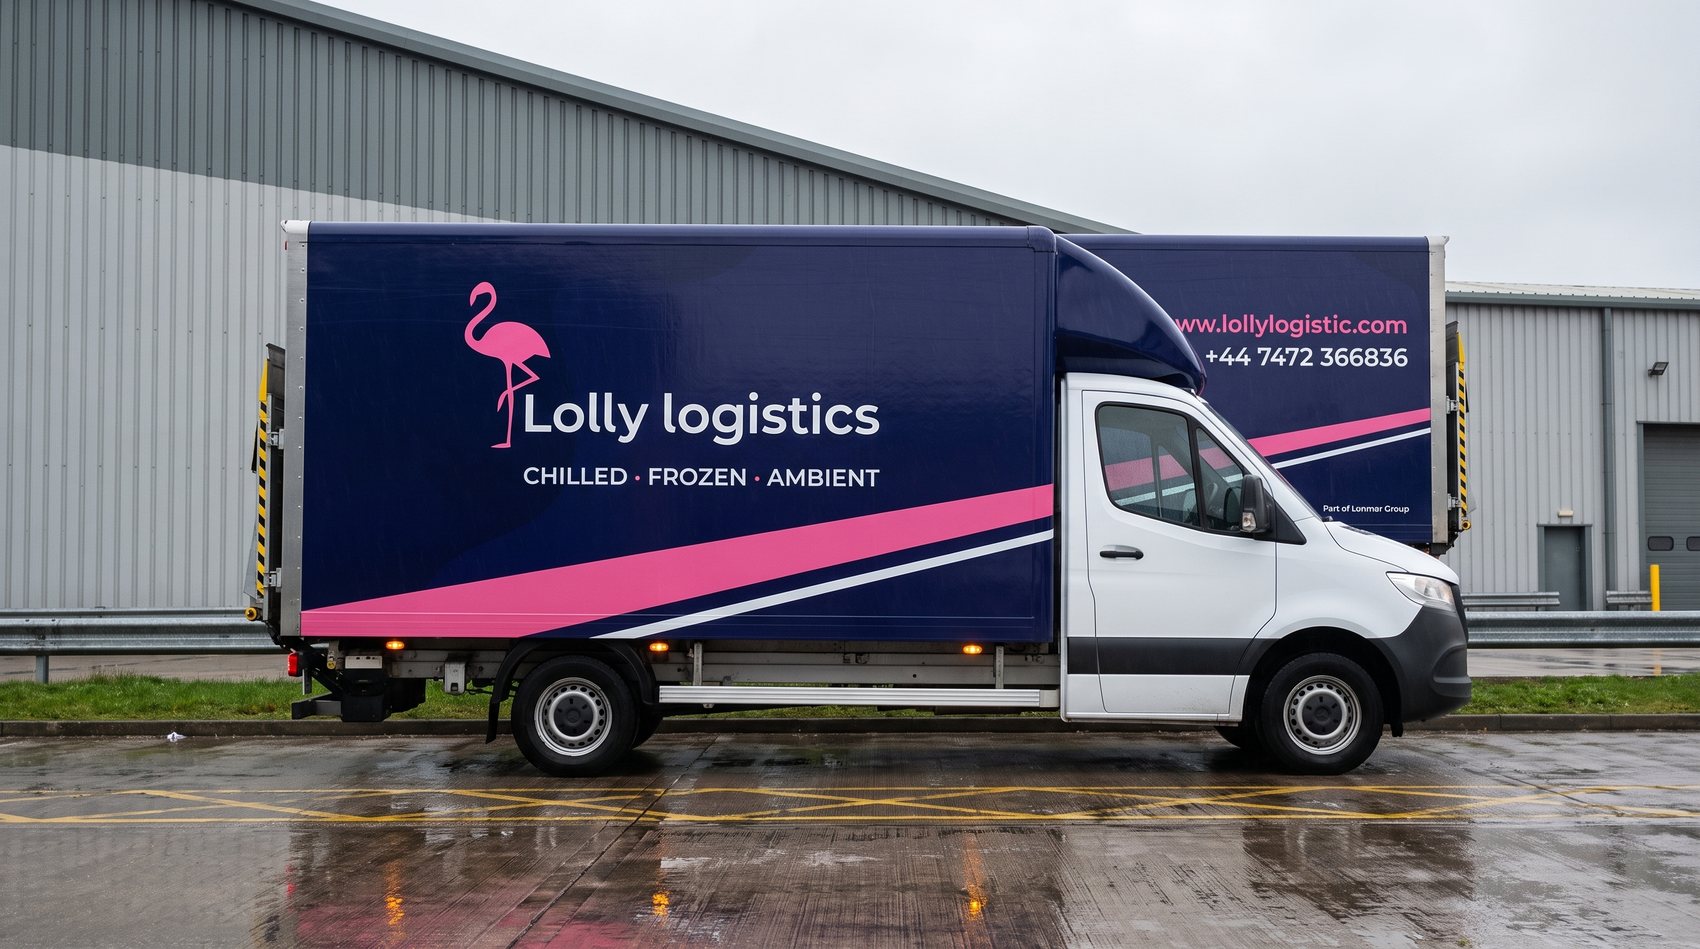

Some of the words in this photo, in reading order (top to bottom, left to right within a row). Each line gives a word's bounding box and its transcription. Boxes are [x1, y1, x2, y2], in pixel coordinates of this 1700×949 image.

[1174, 313, 1408, 339] ww.lollylogistic.com
[1205, 346, 1252, 367] +44
[1257, 346, 1314, 367] 7472
[1319, 346, 1409, 368] 366836
[524, 391, 650, 443] Lolly
[663, 391, 881, 446] logistics
[523, 466, 628, 486] CHILLED
[648, 467, 747, 487] FROZEN
[766, 468, 881, 487] AMBIENT
[1323, 504, 1340, 513] Part
[1341, 504, 1350, 513] of
[1351, 504, 1383, 513] Lonmar
[1384, 505, 1410, 514] Group
